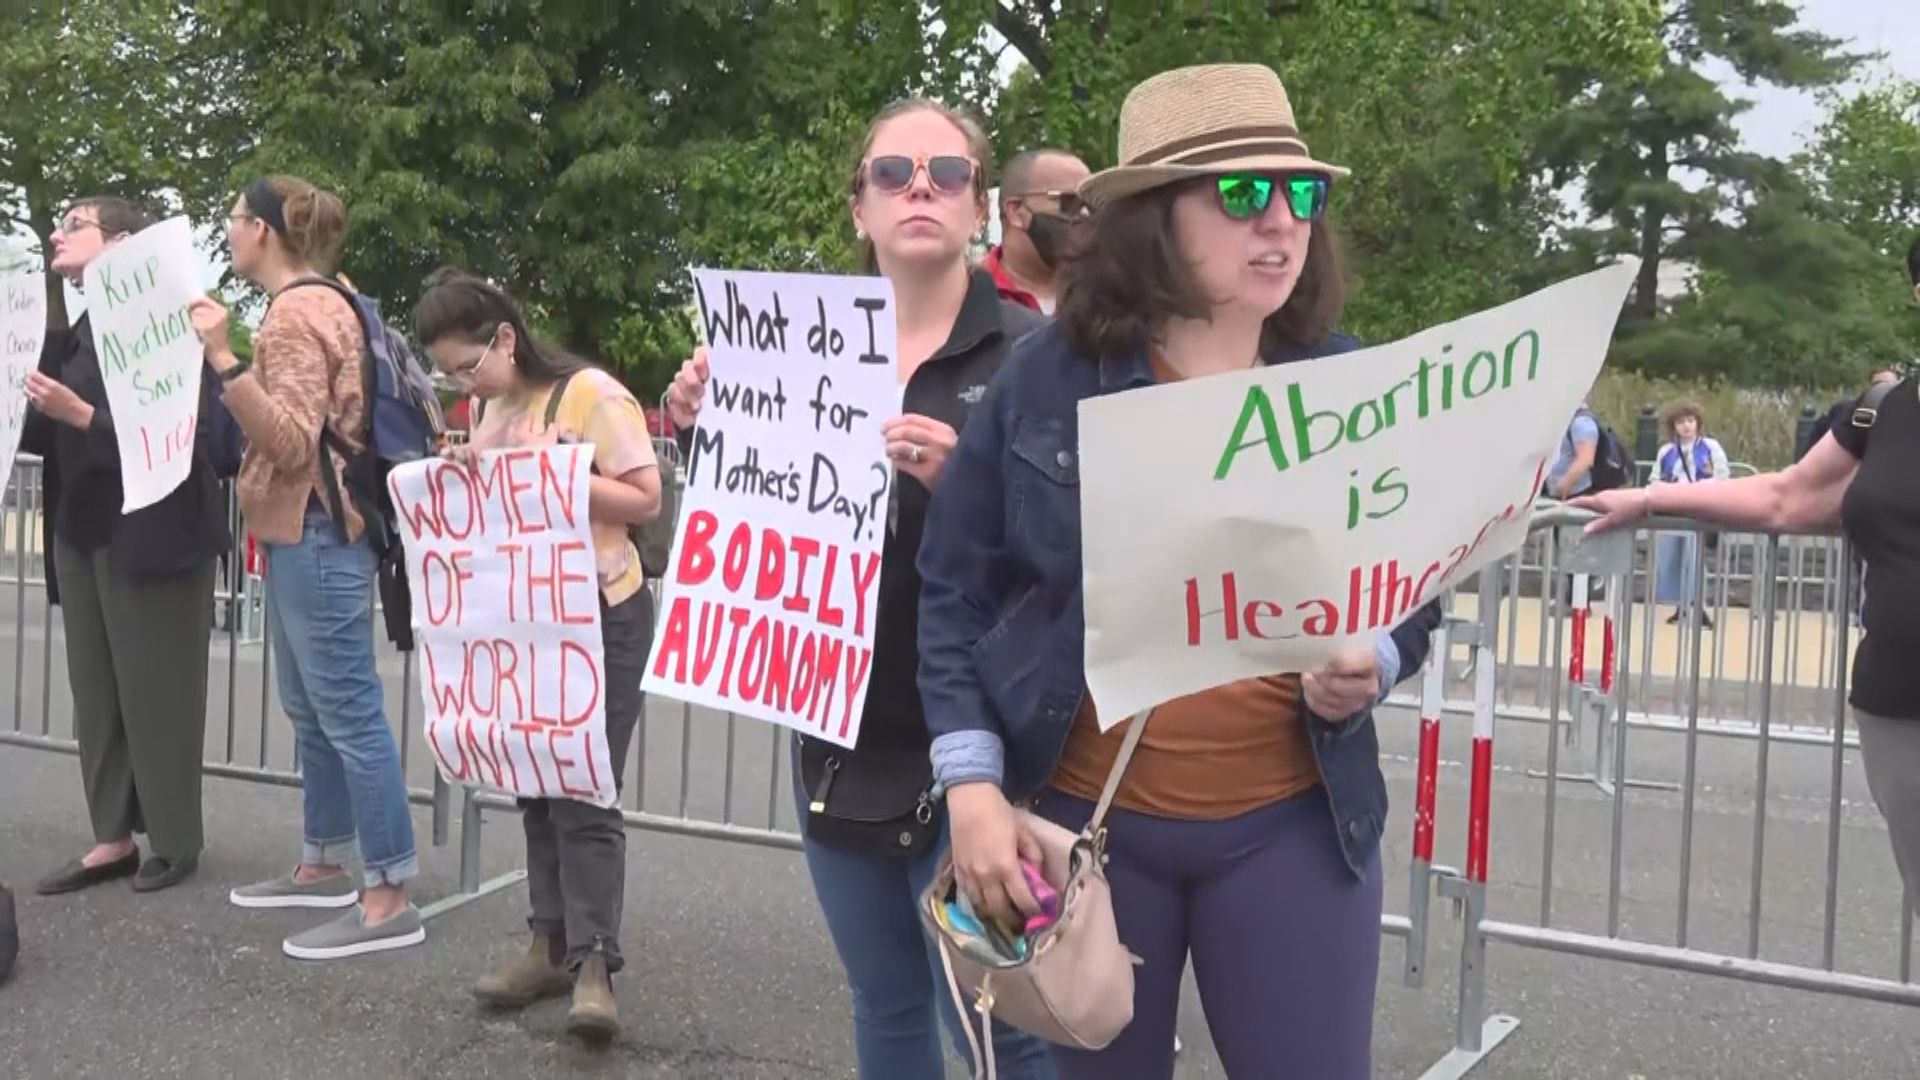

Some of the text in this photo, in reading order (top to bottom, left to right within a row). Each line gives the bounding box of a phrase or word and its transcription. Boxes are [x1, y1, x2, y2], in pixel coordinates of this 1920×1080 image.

[695, 278, 889, 364] What do I
[711, 374, 868, 433] want for
[1214, 329, 1540, 481] Abortion
[391, 447, 577, 542] WOMEN
[689, 425, 888, 541] Mother's Day?
[1347, 466, 1409, 530] is
[422, 541, 594, 627] OF THE
[676, 510, 882, 637] BODILY
[424, 638, 600, 727] WORLD
[652, 597, 872, 740] AUTONOMY
[429, 718, 603, 800] UNITE!
